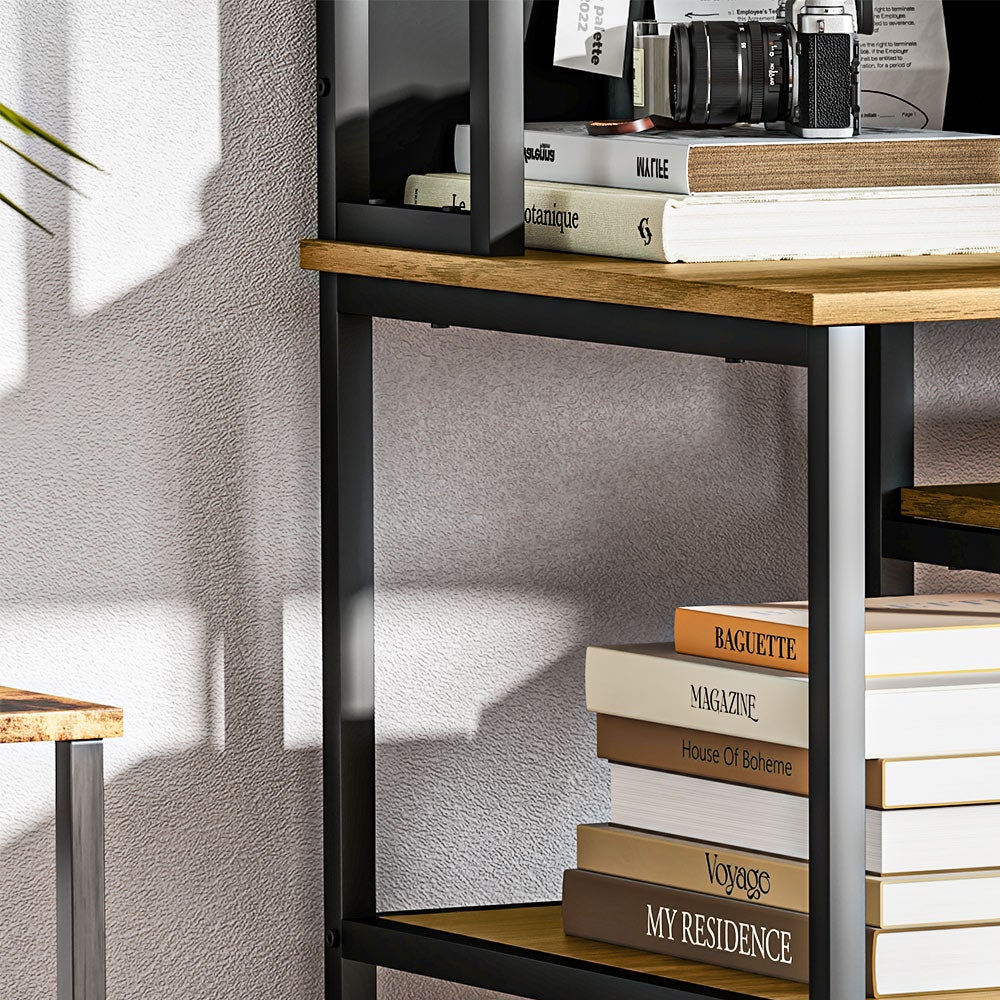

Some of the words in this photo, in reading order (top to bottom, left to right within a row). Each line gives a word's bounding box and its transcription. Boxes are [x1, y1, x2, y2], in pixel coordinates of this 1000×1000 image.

[578, 0, 590, 32] 022
[737, 8, 767, 16] Employee's
[715, 626, 797, 661] BAGUETTE
[690, 684, 759, 723] MAGAZINE
[682, 739, 720, 764] House
[723, 746, 739, 767] Of
[742, 750, 793, 776] Boheme
[705, 852, 771, 900] Voyage
[646, 904, 678, 941] MY
[681, 911, 793, 965] RESIDENCE
